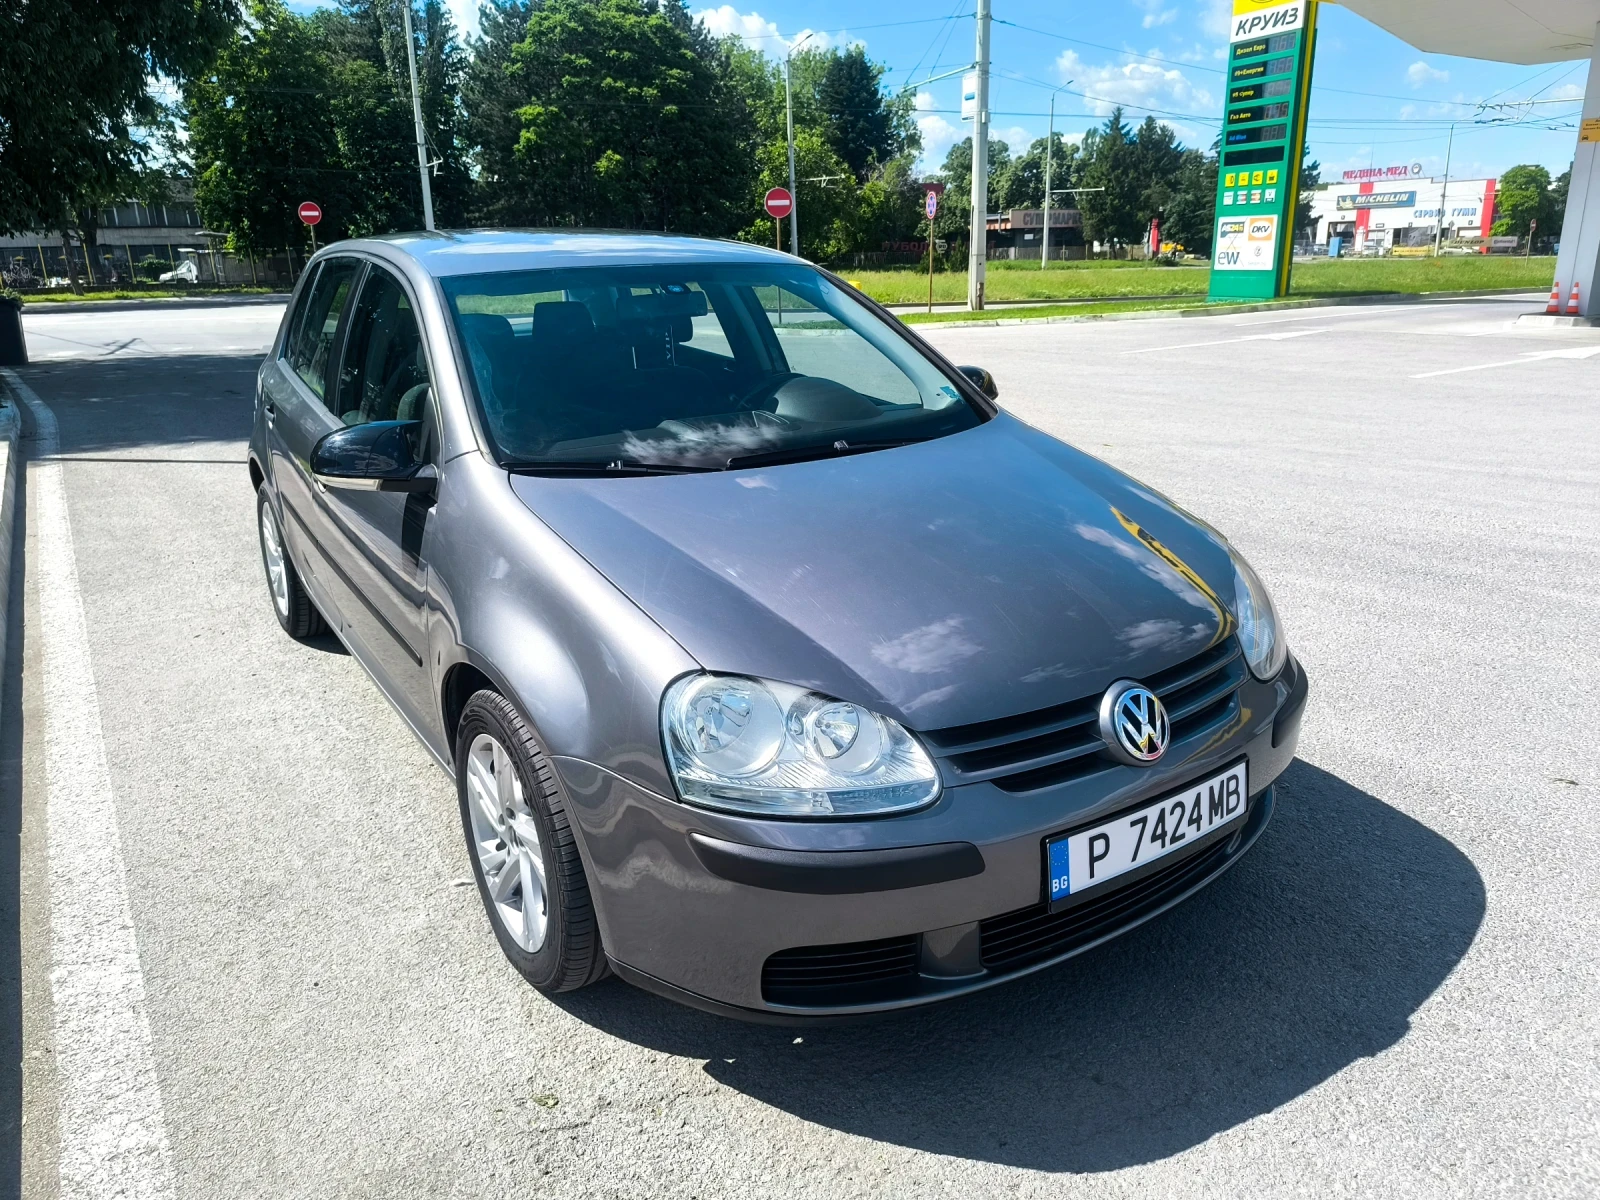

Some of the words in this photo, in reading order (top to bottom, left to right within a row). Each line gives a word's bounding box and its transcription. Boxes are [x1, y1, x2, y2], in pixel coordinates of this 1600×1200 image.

[1235, 7, 1299, 36] КРУИЗ
[1355, 193, 1410, 204] MICHELIN
[1451, 207, 1477, 217] ГУМИ
[1251, 225, 1270, 233] DKV
[1088, 832, 1111, 880] P
[1129, 792, 1203, 863] 7424
[1208, 774, 1241, 826] MB
[1052, 875, 1069, 893] BG
